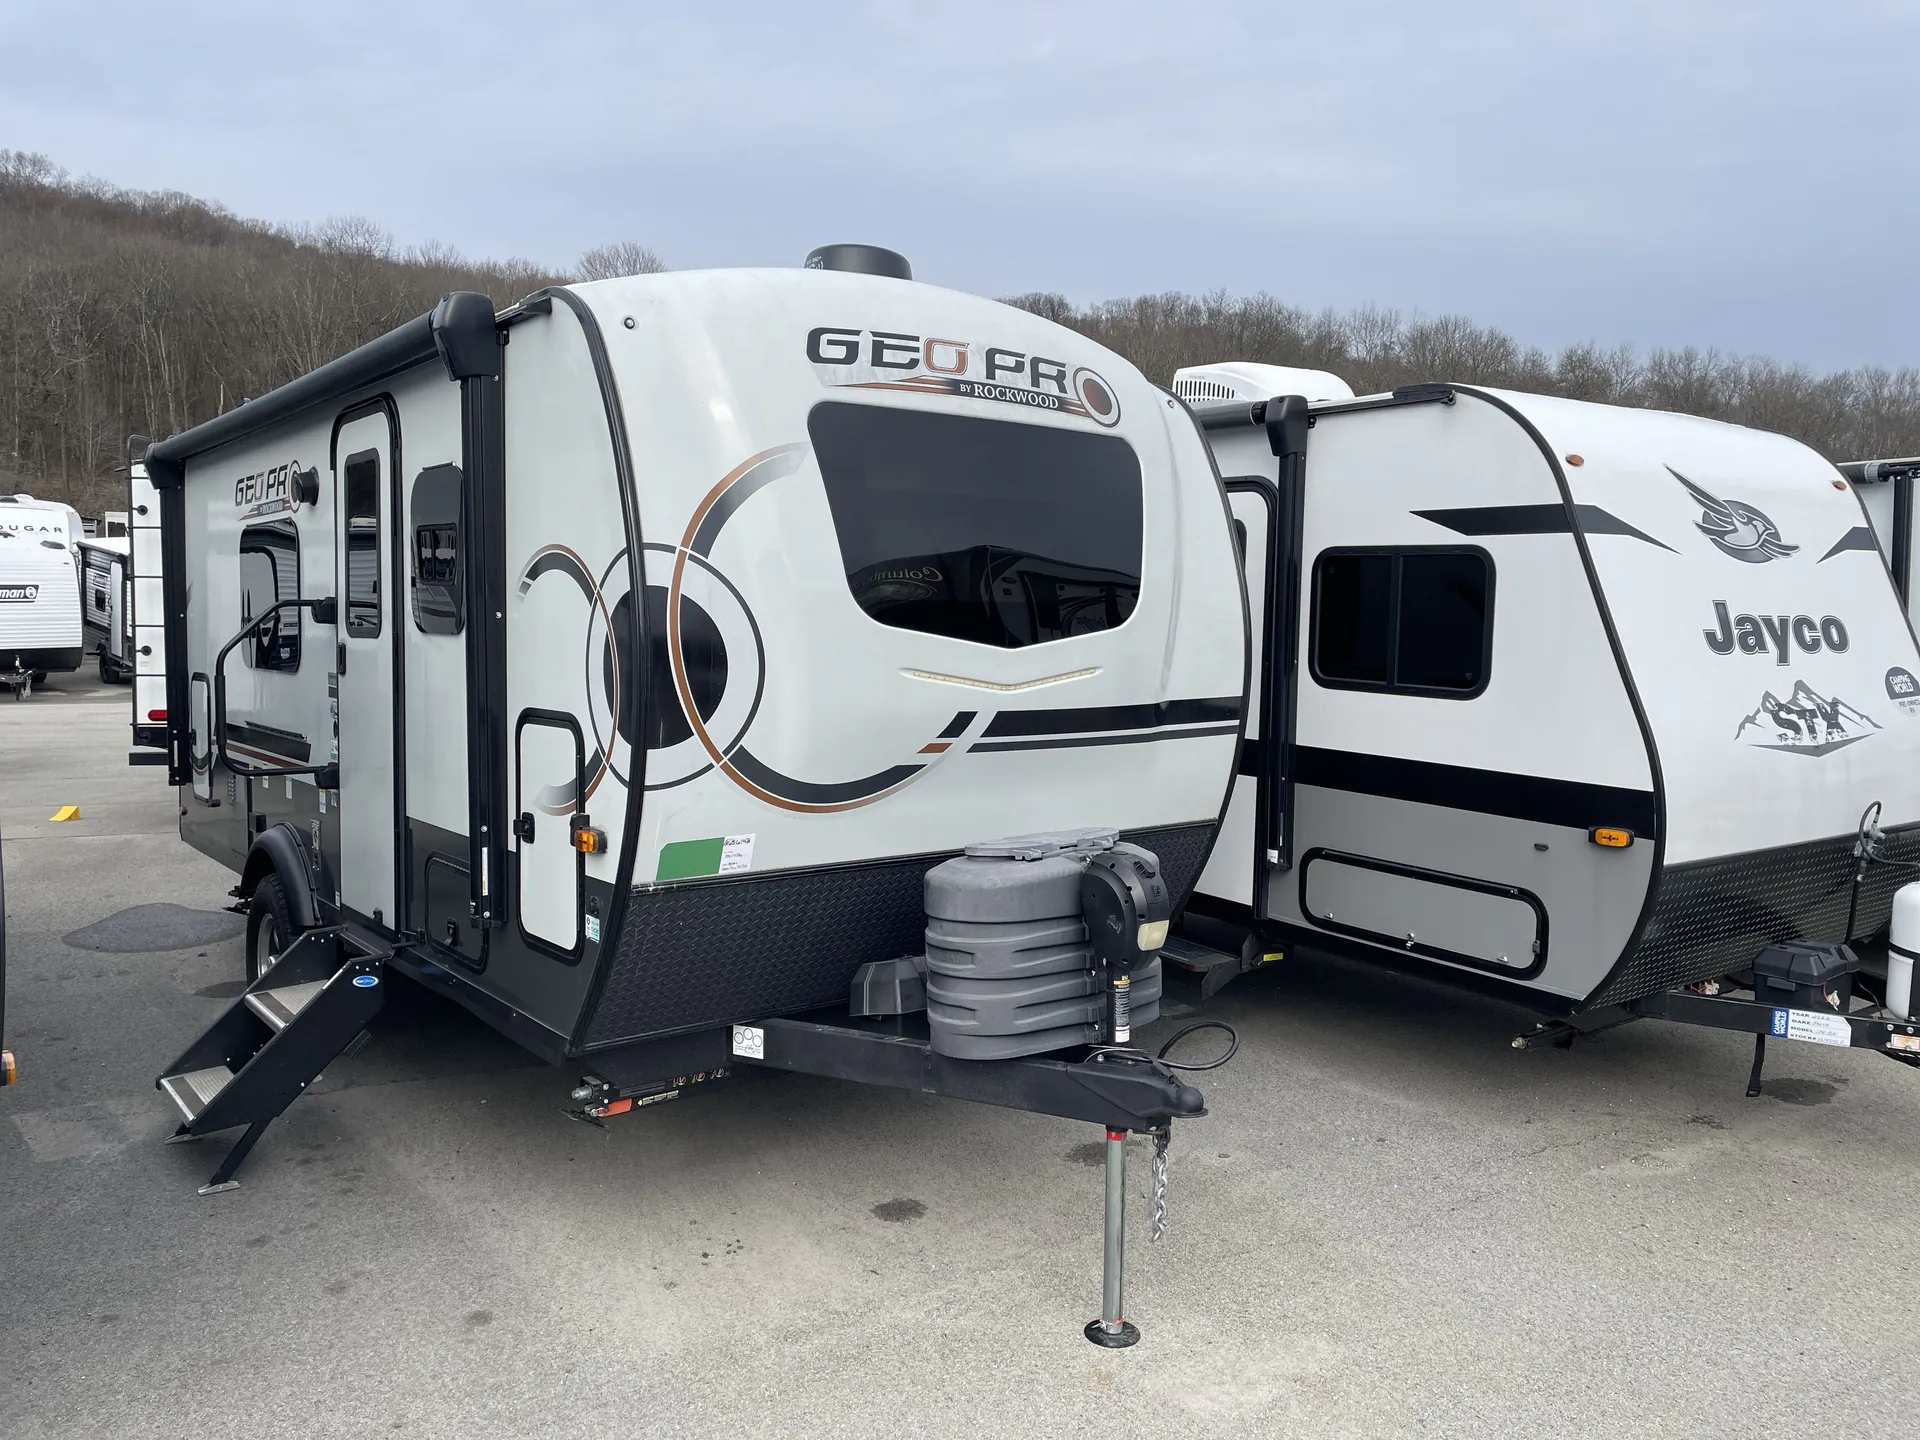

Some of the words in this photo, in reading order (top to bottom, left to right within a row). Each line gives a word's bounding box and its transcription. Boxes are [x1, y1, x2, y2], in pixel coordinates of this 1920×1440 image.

[806, 326, 970, 375] GEO
[960, 383, 971, 392] BY
[973, 383, 1059, 409] ROCKWOOD
[235, 472, 265, 506] GEO
[1703, 600, 1850, 666] Jayco
[1889, 674, 1910, 684] CAMPING
[1892, 682, 1914, 694] WORLD
[1773, 1010, 1782, 1035] CAMPING
[1779, 1011, 1787, 1034] WORLD
